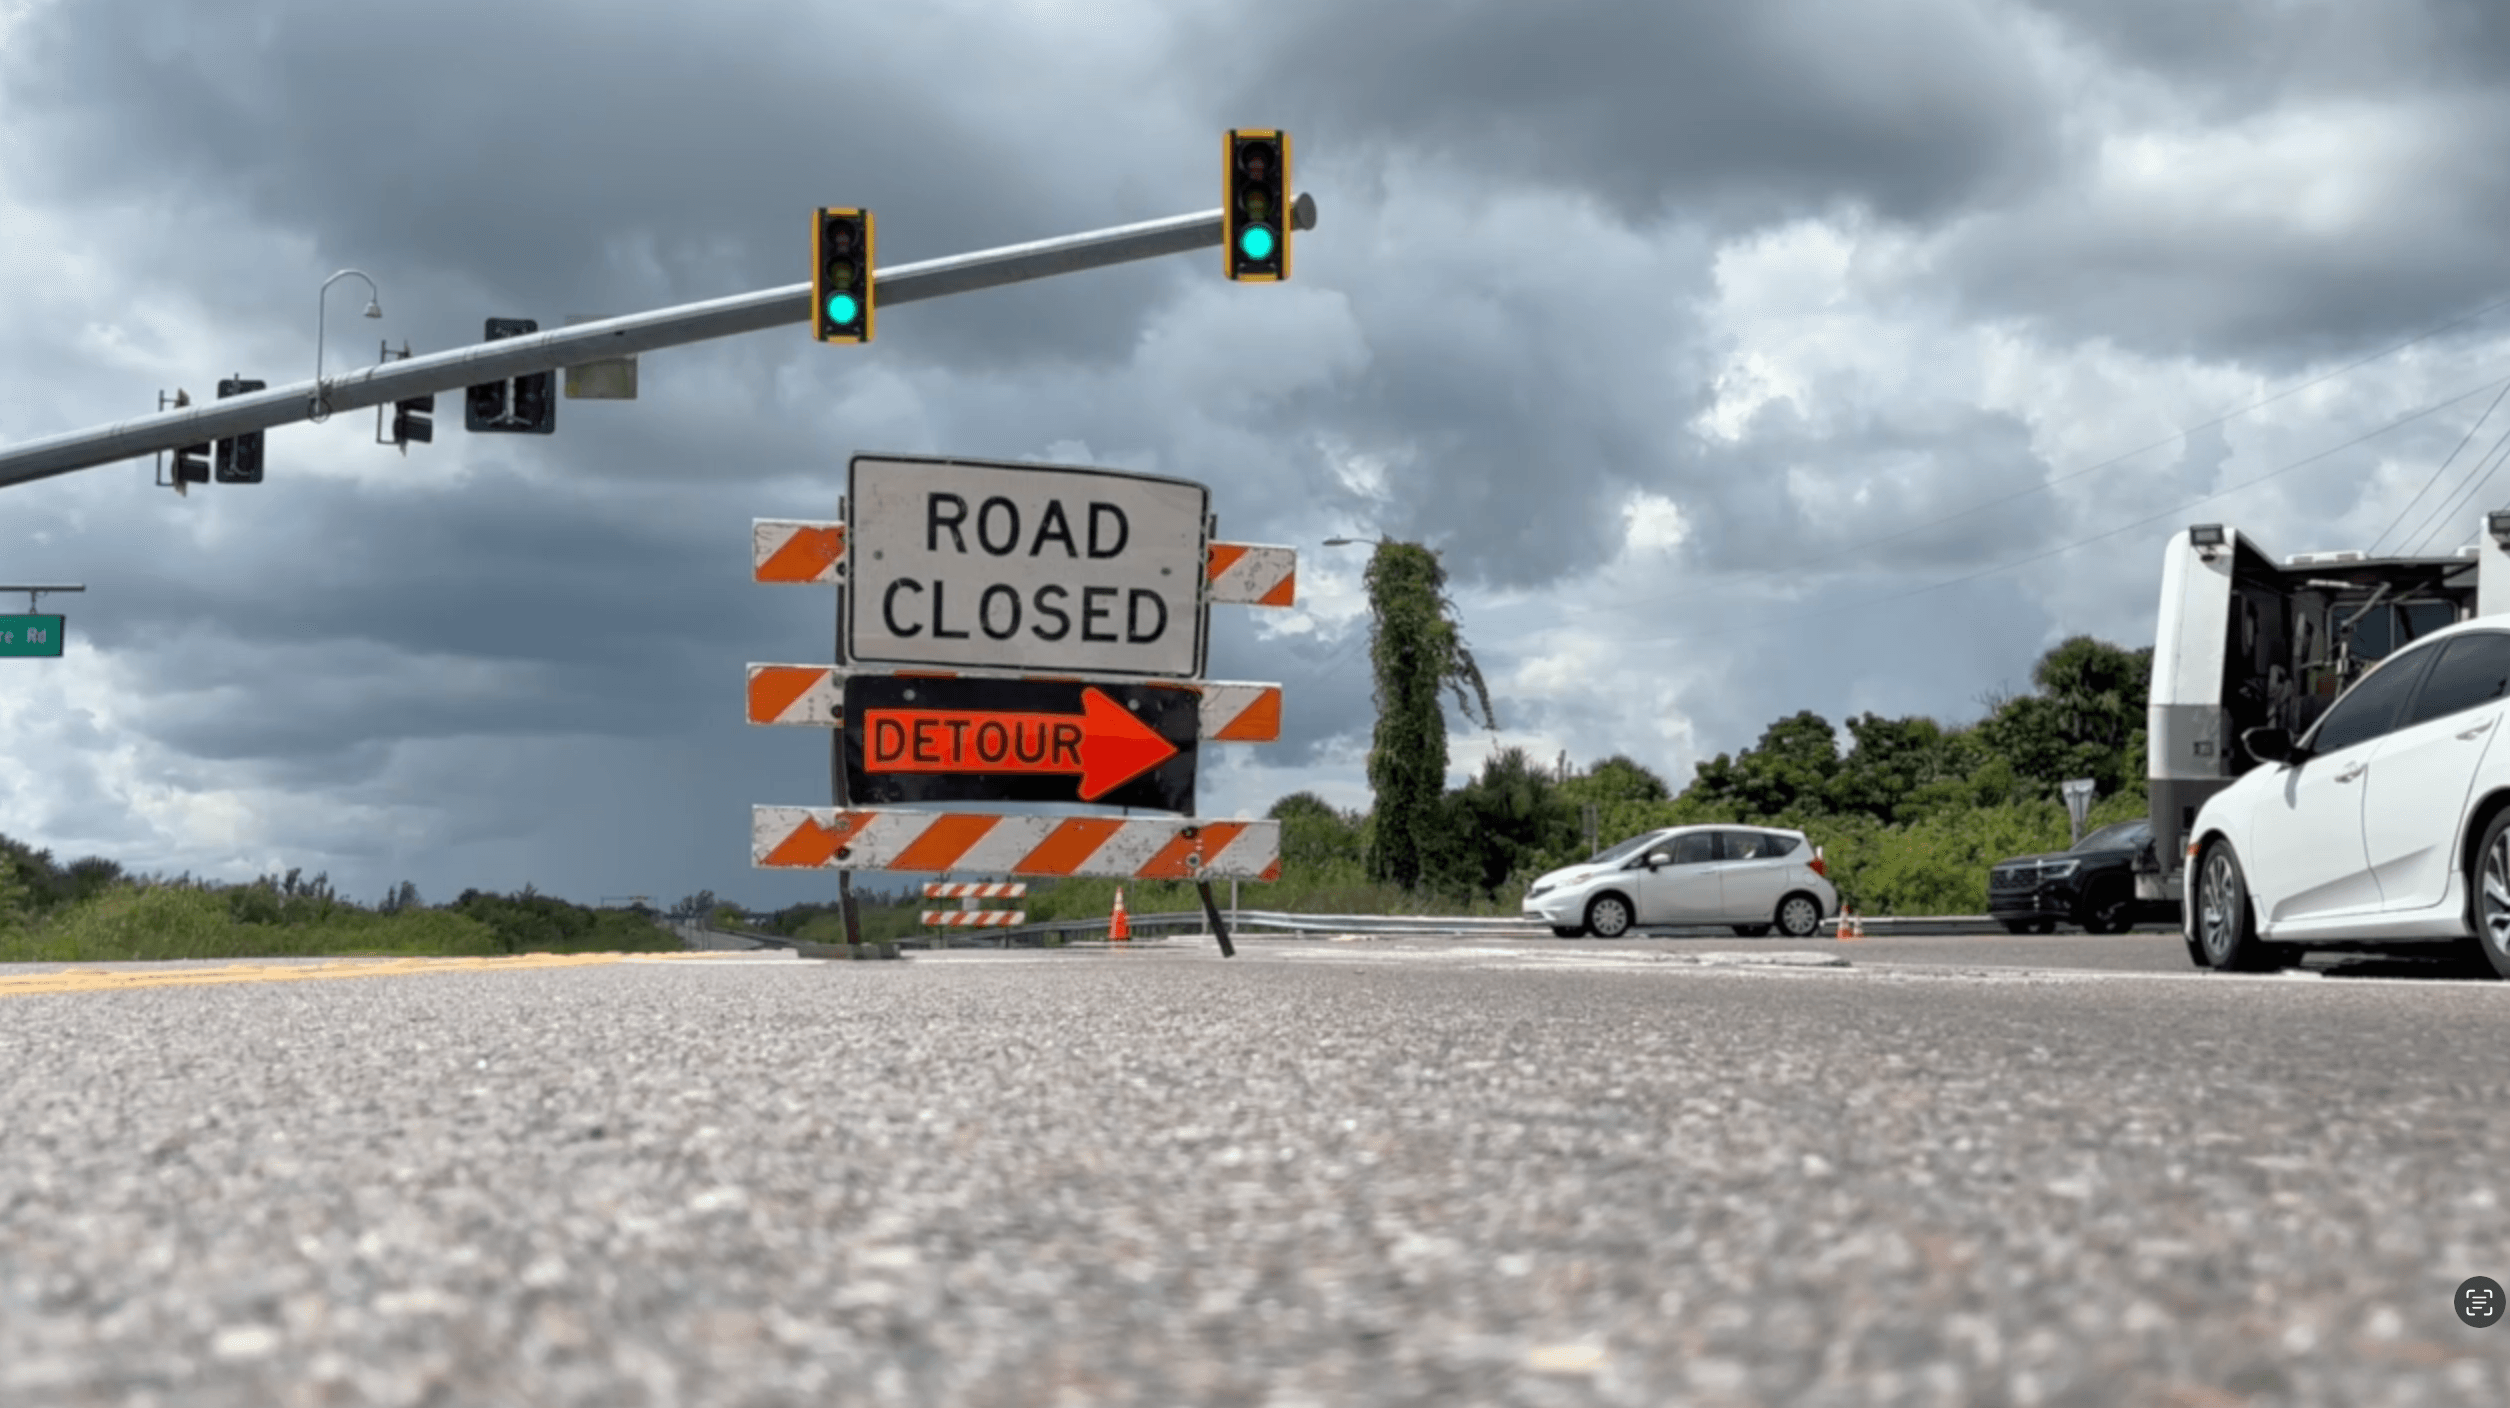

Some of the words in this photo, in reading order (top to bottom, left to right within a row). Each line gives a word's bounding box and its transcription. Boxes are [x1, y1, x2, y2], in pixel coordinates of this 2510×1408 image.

[927, 492, 1130, 559] ROAD
[27, 626, 47, 645] Rd
[883, 577, 1168, 644] CLOSED
[875, 718, 1083, 765] DETOUR
